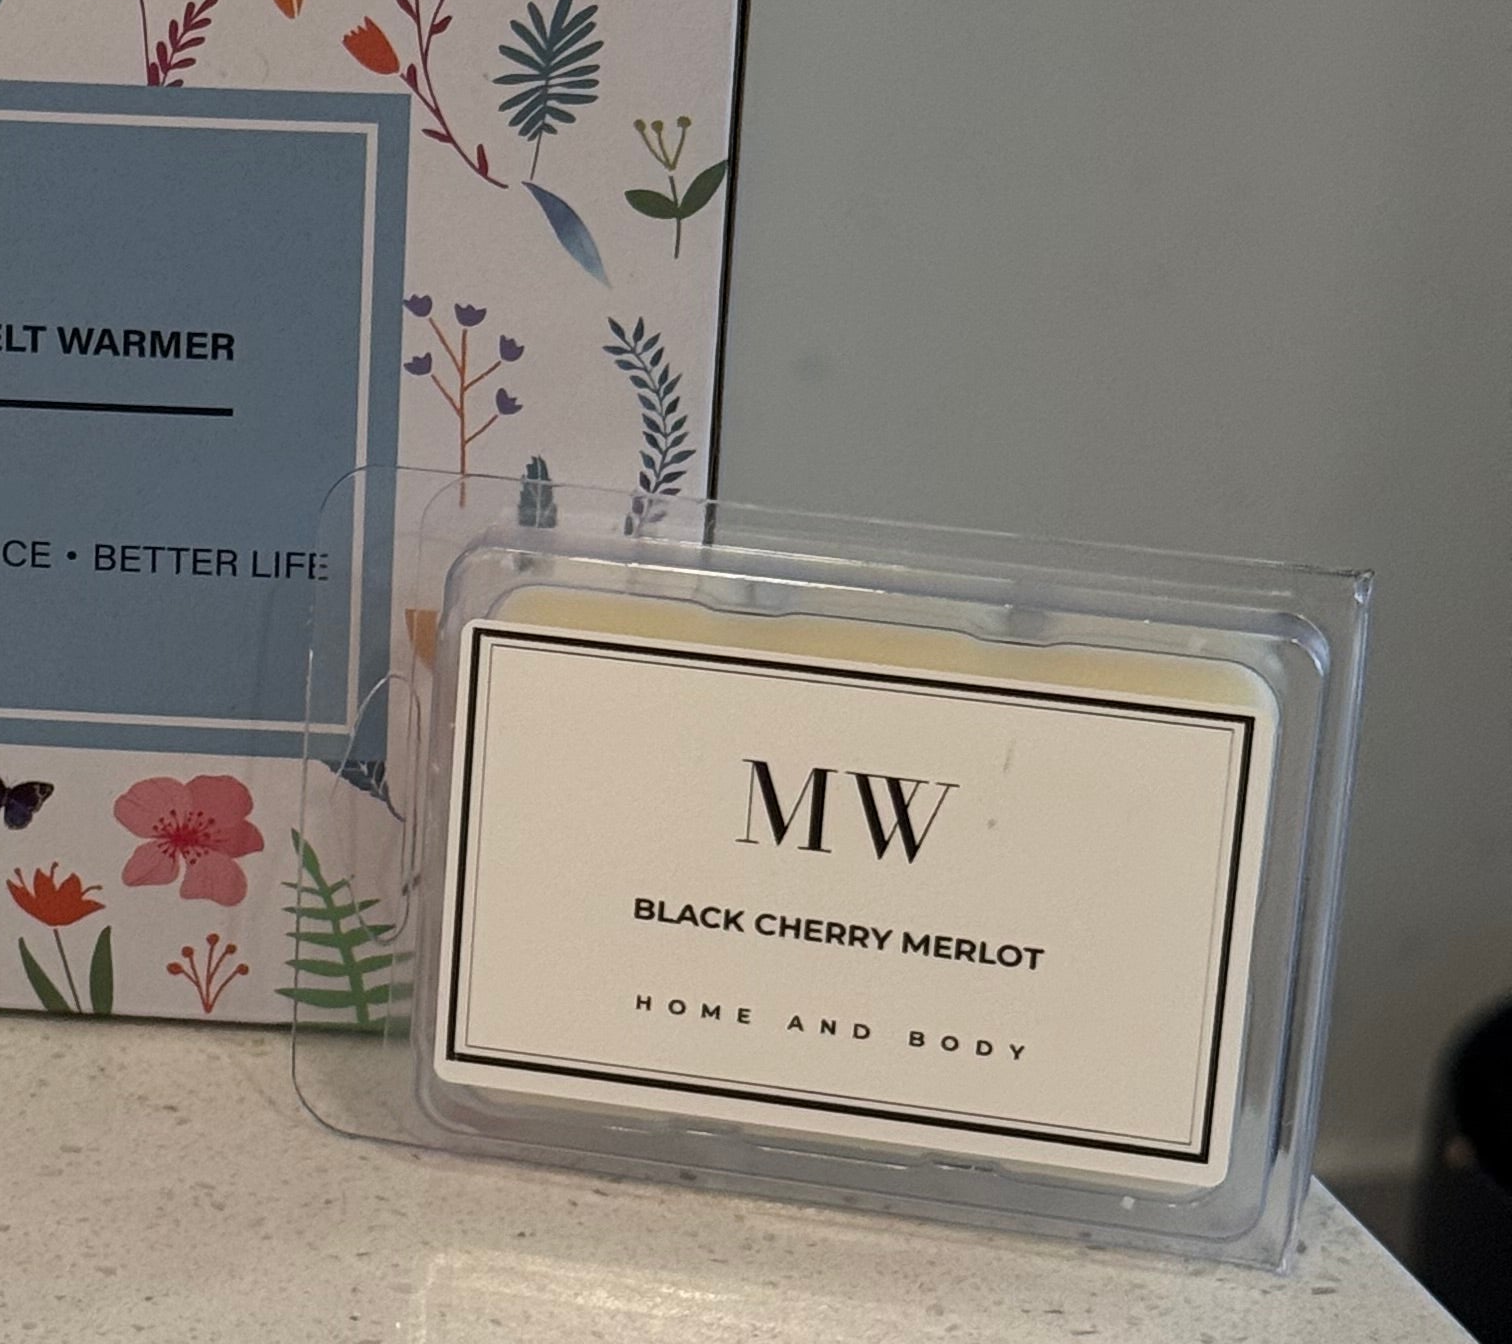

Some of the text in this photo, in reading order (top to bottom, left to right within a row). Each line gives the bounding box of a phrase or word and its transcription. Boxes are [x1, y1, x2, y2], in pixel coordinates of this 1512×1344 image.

[56, 326, 235, 361] WARMER
[94, 543, 238, 577] BETTER
[251, 550, 329, 581] LIFE
[735, 758, 960, 864] MW
[633, 897, 1046, 971] BLACK CHERRY MERLOT
[635, 994, 1025, 1061] HOME AND BODY
